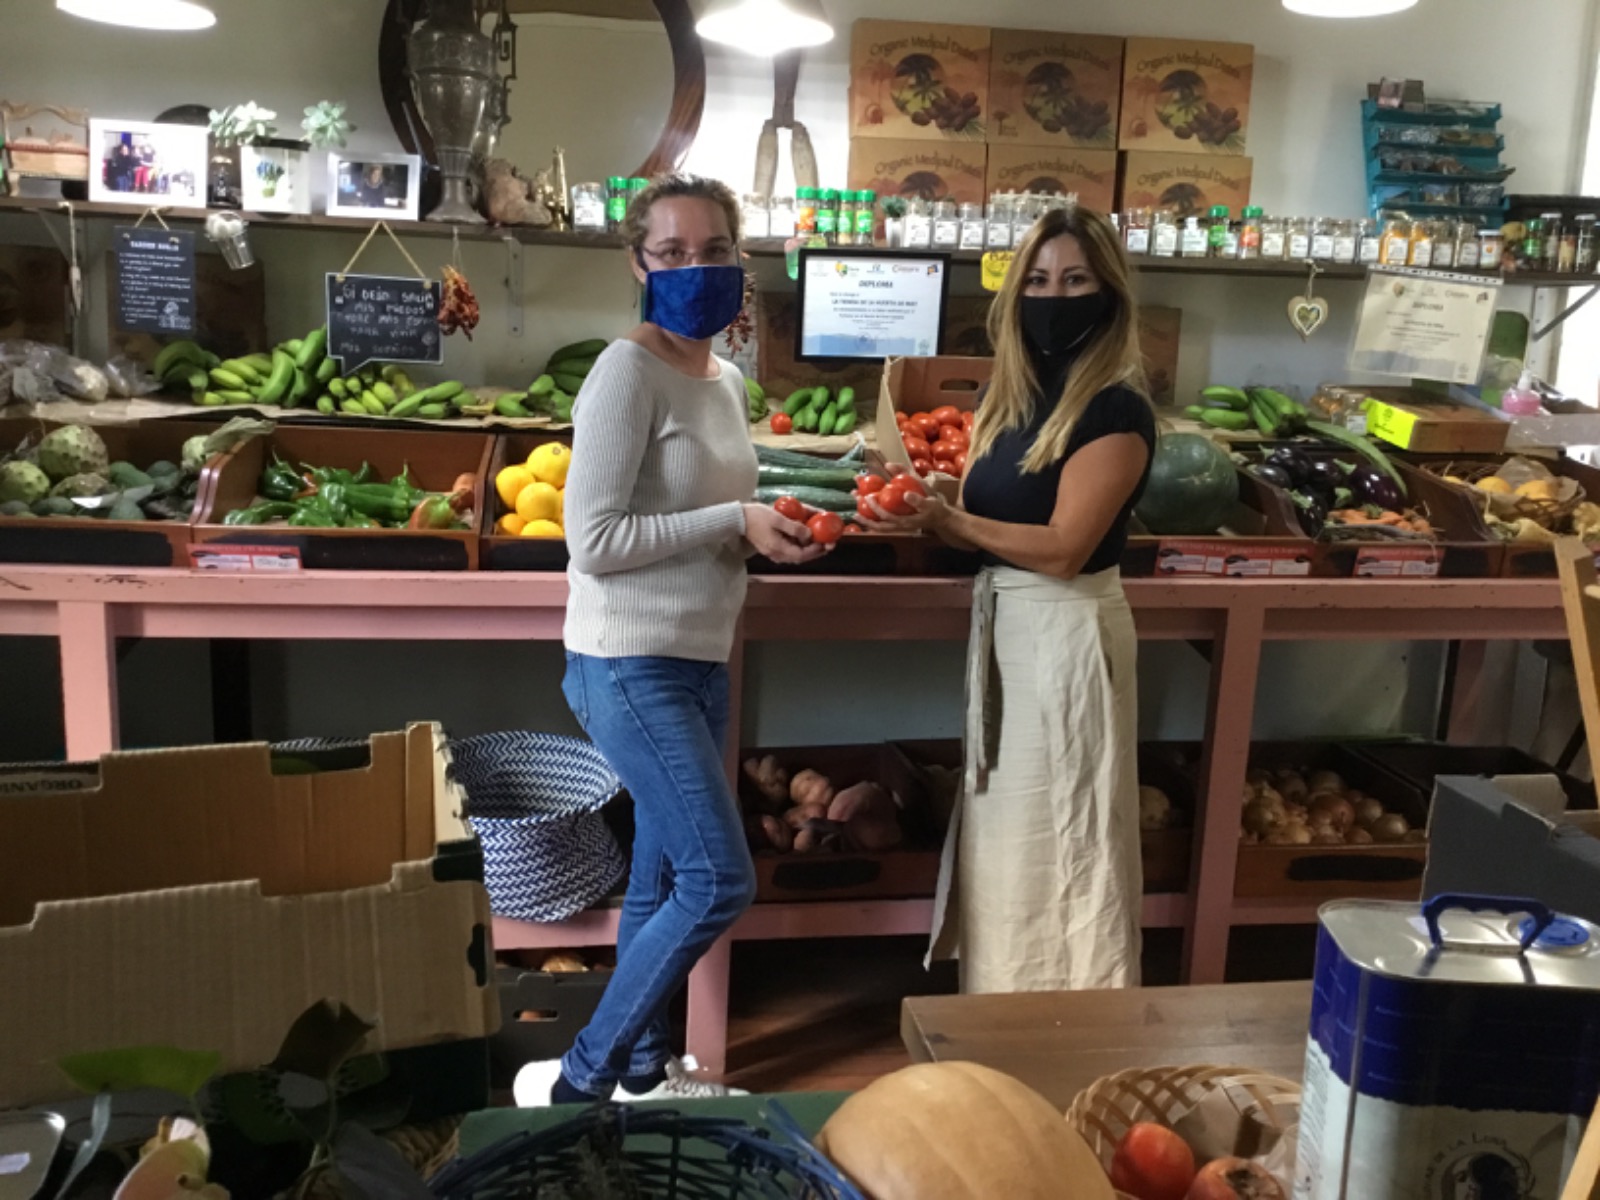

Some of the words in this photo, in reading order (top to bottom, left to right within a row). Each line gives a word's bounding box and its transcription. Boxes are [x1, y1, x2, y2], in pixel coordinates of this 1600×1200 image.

[870, 38, 909, 57] Organic
[951, 41, 979, 62] Dates
[1003, 48, 1041, 66] Organic
[1137, 54, 1175, 73] Organic
[1215, 58, 1240, 79] Dates
[874, 155, 913, 175] Organic
[998, 162, 1036, 180] Organic
[1137, 168, 1175, 187] Organic
[1213, 170, 1239, 190] Dates
[0, 778, 83, 793] ORGANI
